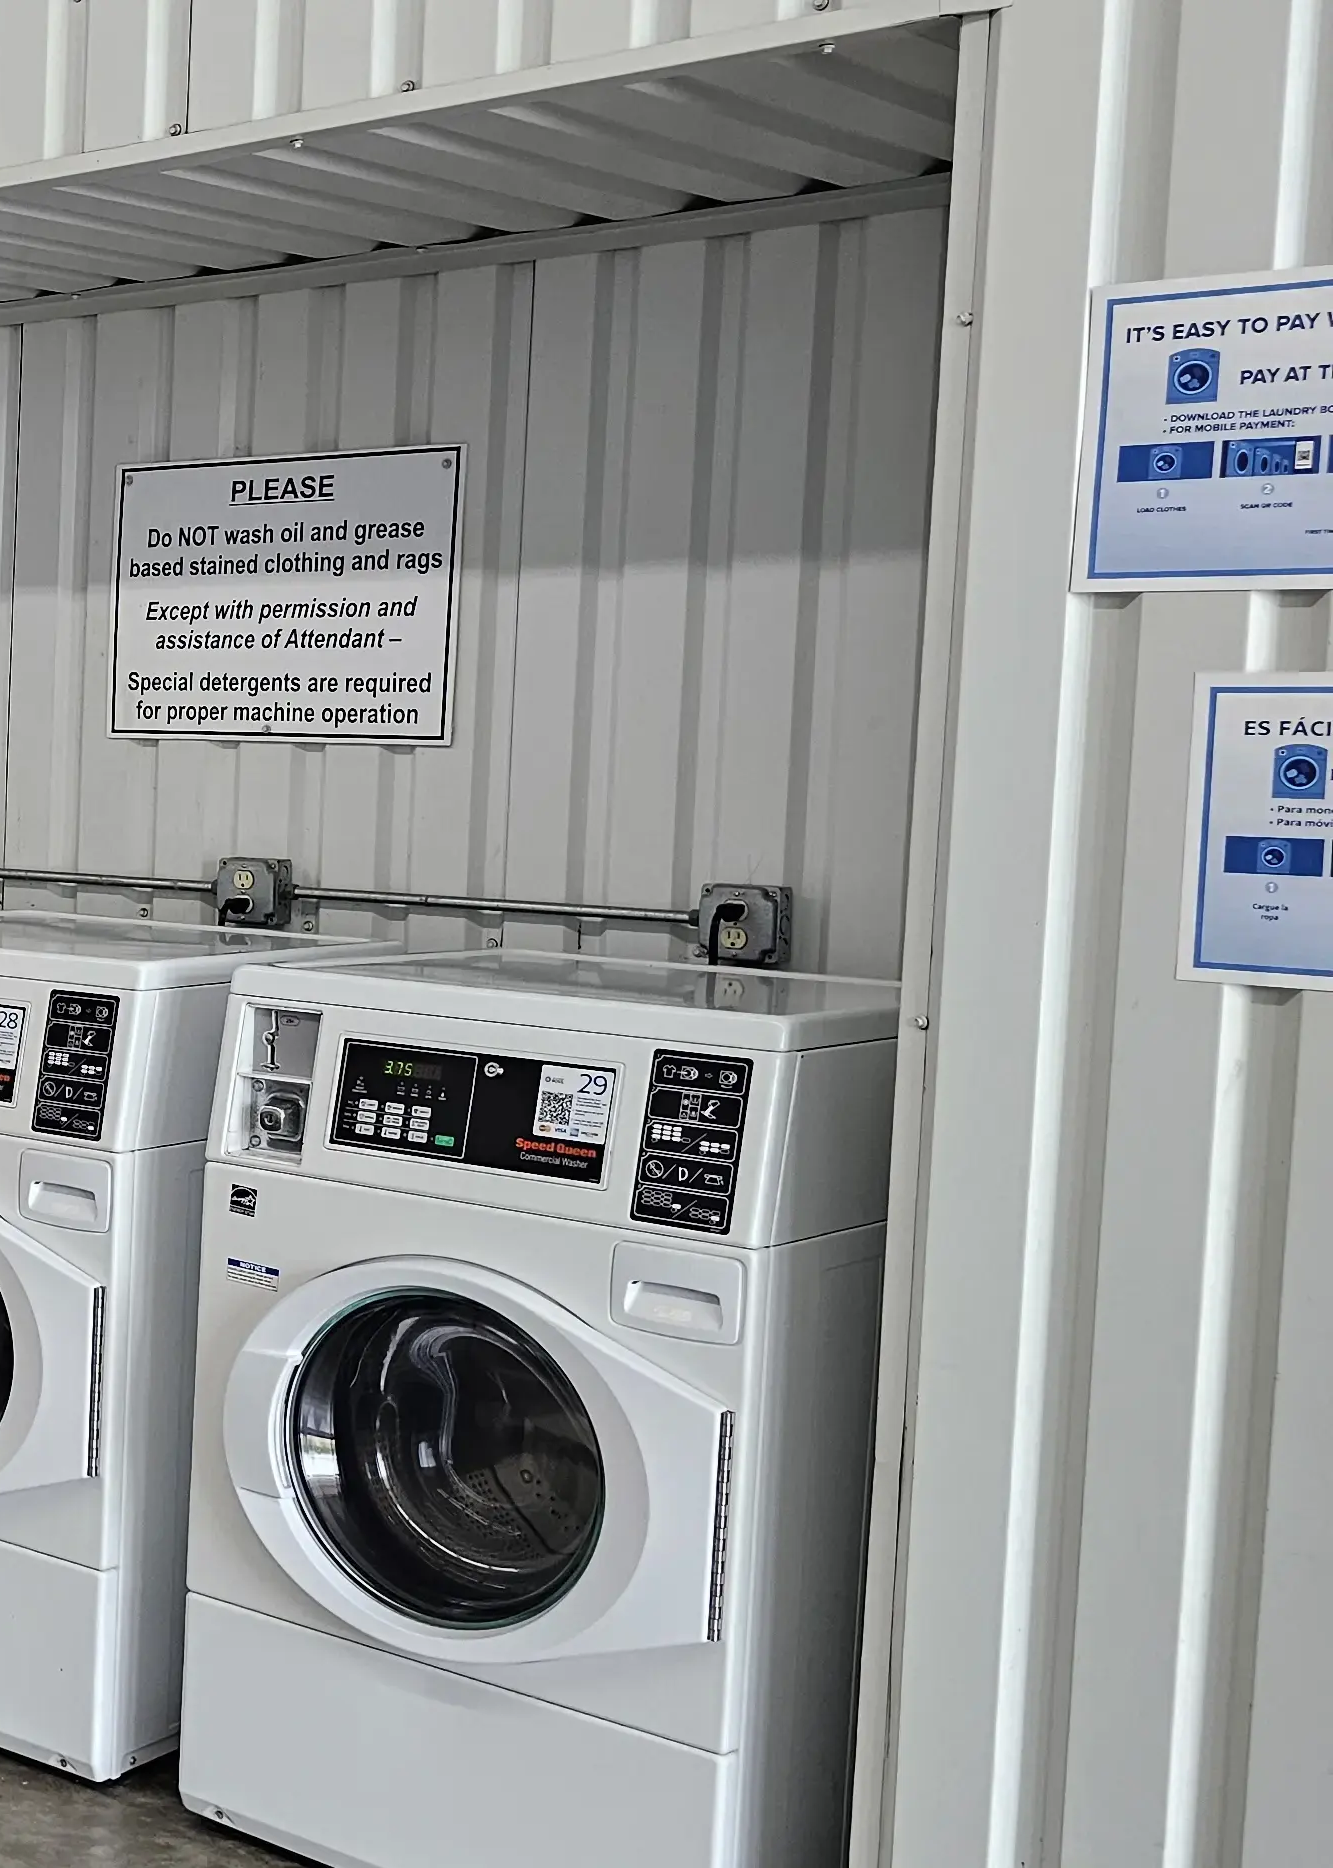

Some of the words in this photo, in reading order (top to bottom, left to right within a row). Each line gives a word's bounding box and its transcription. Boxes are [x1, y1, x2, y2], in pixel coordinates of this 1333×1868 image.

[1126, 325, 1165, 343] IT'S
[1172, 319, 1231, 339] EASY
[1237, 317, 1268, 334] TO
[1276, 312, 1320, 332] PAY
[1240, 368, 1280, 385] PAY
[1284, 366, 1311, 382] AT
[1170, 411, 1235, 423] DOWNLOAD
[1238, 410, 1259, 419] THE
[1263, 406, 1317, 417] LAUNDRY
[1169, 425, 1191, 434] FOR
[1194, 423, 1236, 433] MOBILE
[1239, 420, 1295, 430] PAYMENT:
[231, 474, 335, 502] PLEASE
[148, 528, 172, 548] Do
[178, 525, 219, 547] NOT
[224, 523, 274, 545] wash
[281, 522, 304, 543] oil
[310, 520, 347, 541] and
[354, 520, 425, 546] grease
[129, 557, 184, 578] based
[189, 554, 258, 576] stained
[264, 552, 344, 577] clothing
[351, 549, 389, 571] and
[396, 549, 443, 575] rags
[145, 601, 209, 625] Except
[214, 598, 253, 620] with
[258, 597, 370, 624] permission
[377, 596, 418, 617] and
[155, 630, 255, 650] assistance
[261, 628, 283, 649] of
[284, 628, 385, 649] Attendant
[128, 671, 193, 694] Special
[199, 671, 301, 696] detergents
[307, 674, 338, 692] are
[345, 672, 432, 697] required
[136, 700, 161, 720] for
[167, 704, 227, 725] proper
[233, 702, 315, 723] machine
[322, 703, 419, 727] operation
[1244, 720, 1271, 736] ES
[1277, 805, 1302, 814] Para
[1276, 818, 1301, 827] Para
[577, 1073, 608, 1096] 29
[515, 1137, 555, 1153] Speed
[556, 1142, 597, 1158] Queen
[519, 1151, 561, 1165] Commercial
[561, 1157, 589, 1169] Washer
[239, 1261, 267, 1273] NOTICE
